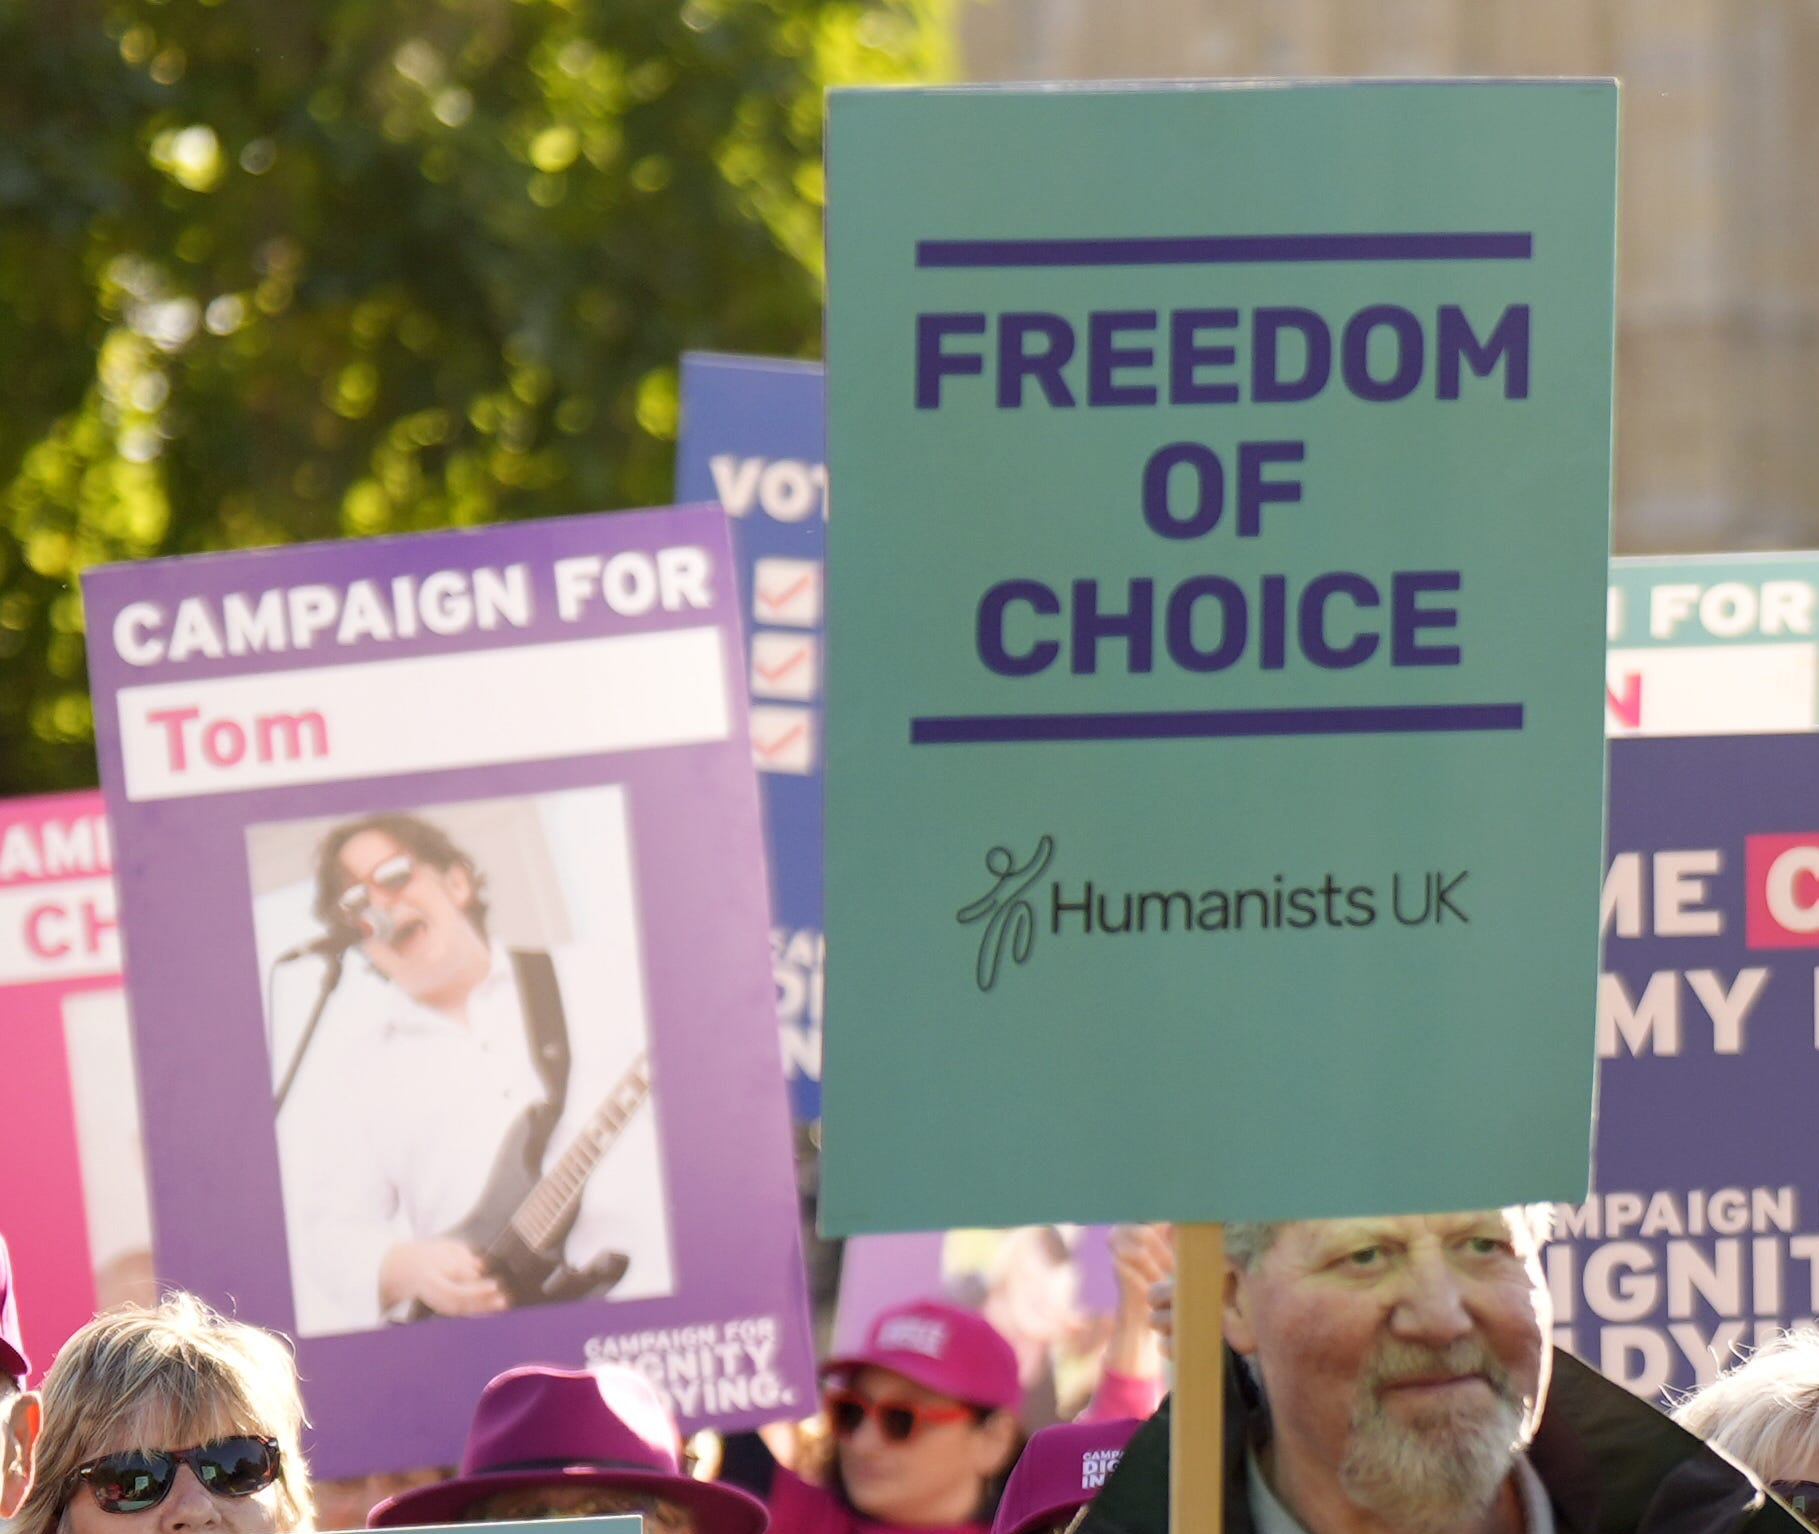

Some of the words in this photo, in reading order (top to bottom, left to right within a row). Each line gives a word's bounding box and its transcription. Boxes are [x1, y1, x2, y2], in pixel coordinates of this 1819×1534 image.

[914, 303, 1531, 409] FREEDOM
[711, 456, 828, 521] VO
[1141, 441, 1304, 539] OF
[112, 562, 530, 667] CAMPAIGN
[554, 546, 714, 622] FOR
[975, 570, 1461, 676] CHOICE
[1650, 580, 1815, 640] FOR
[147, 704, 331, 774] Tom
[1051, 874, 1375, 934] Humanists
[1392, 868, 1470, 928] UK
[1595, 966, 1770, 1058] MY
[1554, 1186, 1793, 1239] MPAIGN
[664, 1371, 795, 1417] YING.
